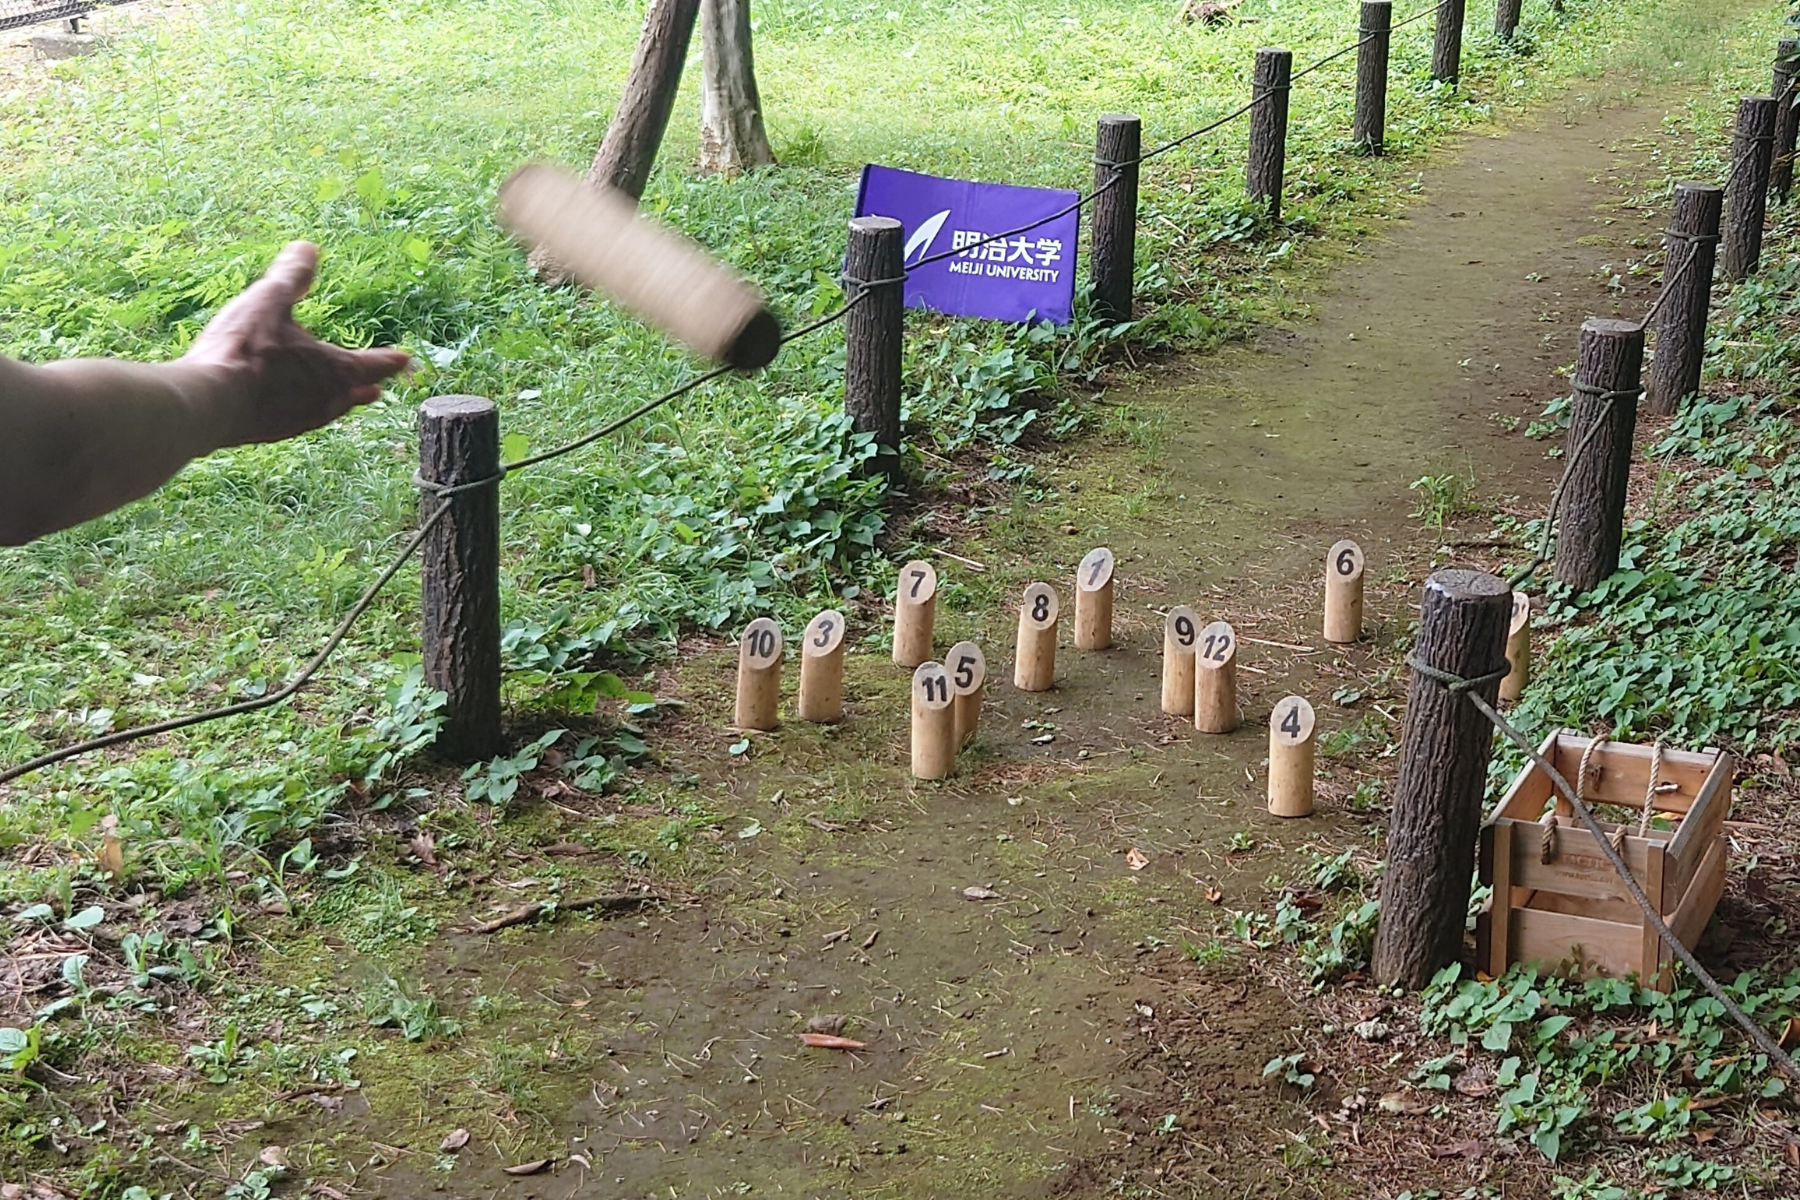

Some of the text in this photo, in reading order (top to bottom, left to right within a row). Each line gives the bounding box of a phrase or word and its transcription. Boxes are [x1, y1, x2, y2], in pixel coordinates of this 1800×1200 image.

[952, 230, 1063, 266] 明治大学
[949, 261, 1060, 283] MEIJI UNIVERSITY
[1088, 558, 1106, 586] 1
[1336, 549, 1355, 575] 6
[910, 570, 926, 598] 7
[1032, 594, 1049, 622] 8
[747, 629, 776, 658] 10
[813, 620, 834, 648] 3
[1175, 615, 1195, 646] 9
[1203, 634, 1231, 662] 12
[954, 655, 976, 689] 5
[922, 675, 947, 702] 11
[1280, 705, 1301, 738] 4
